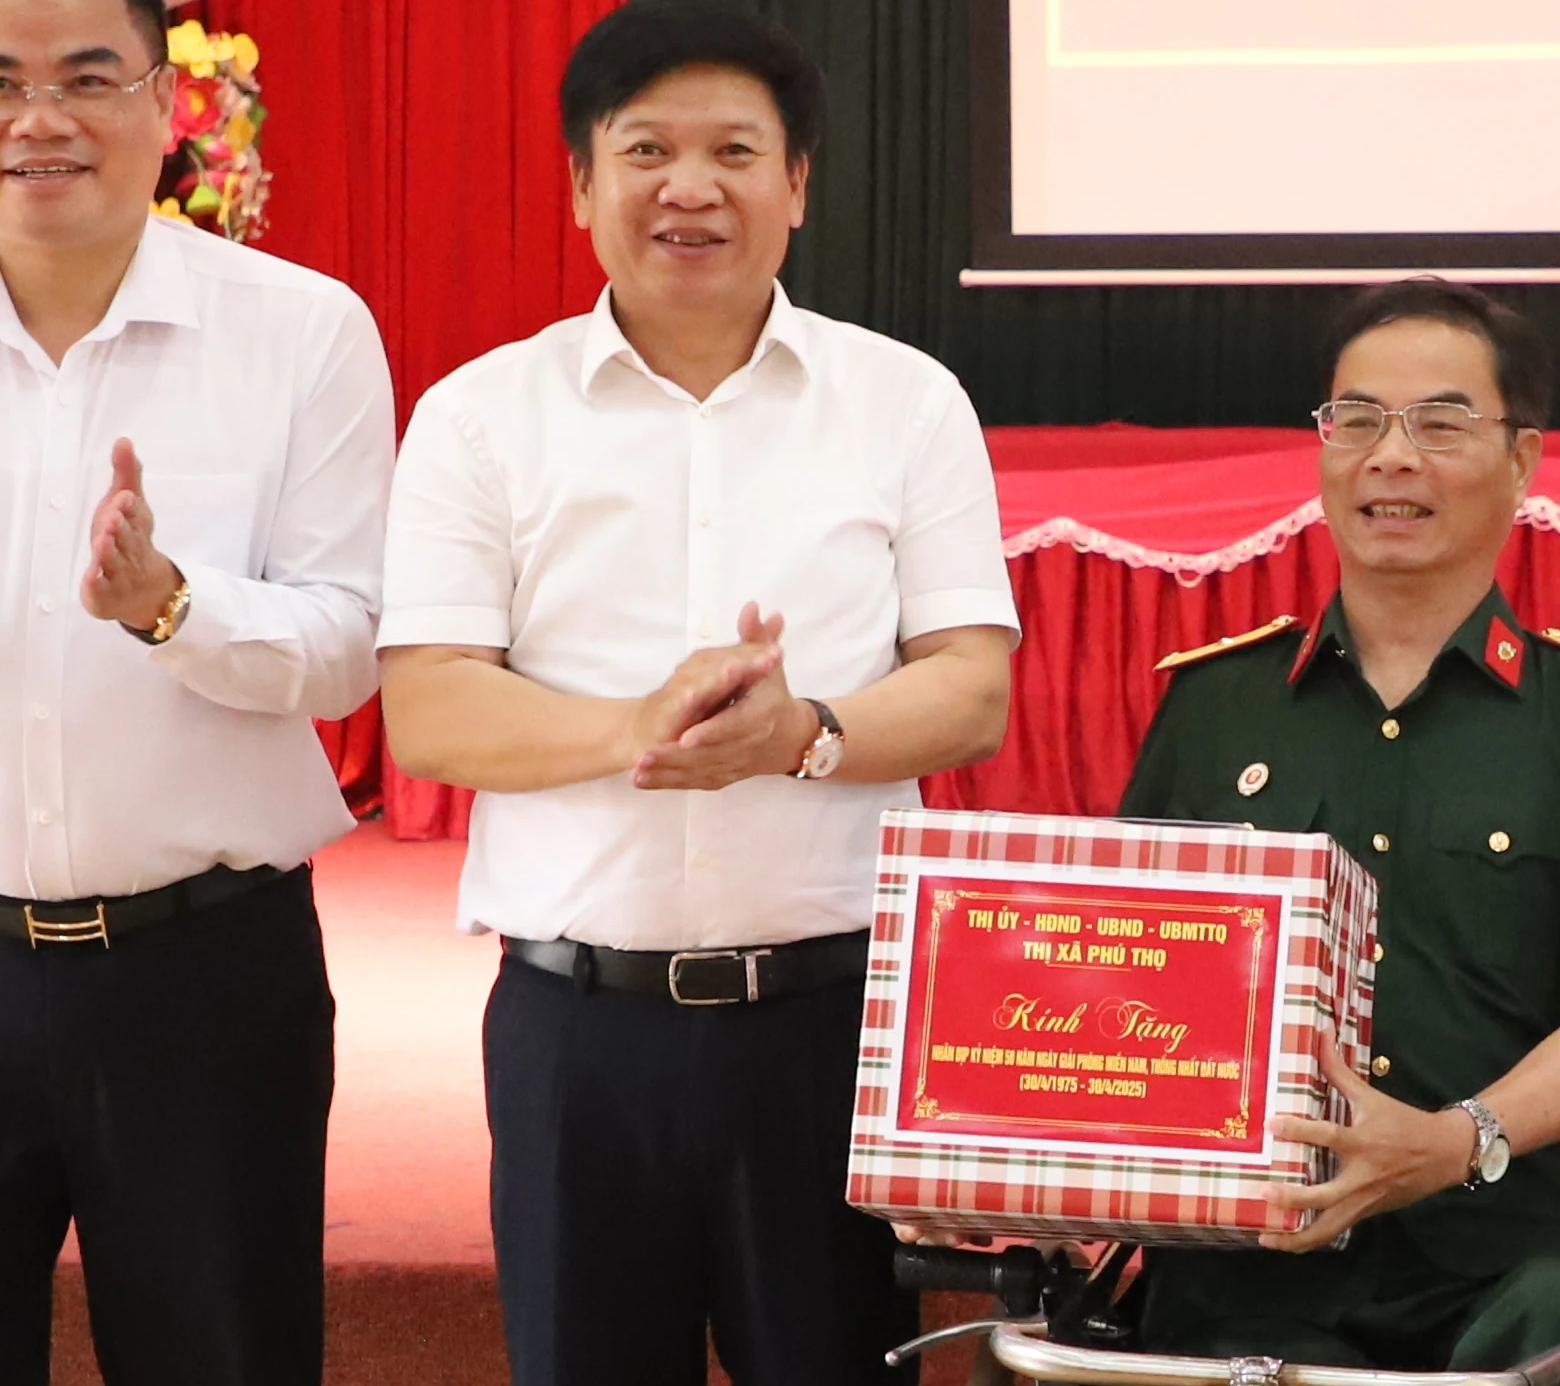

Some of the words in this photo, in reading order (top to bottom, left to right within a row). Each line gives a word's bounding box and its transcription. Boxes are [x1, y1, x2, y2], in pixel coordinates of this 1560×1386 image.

[968, 909, 993, 932] THỊ
[997, 906, 1020, 930] ỦY
[1035, 913, 1081, 934] HĐND
[1097, 916, 1144, 938] UBND
[1159, 920, 1228, 945] UBMTTQ
[1023, 941, 1052, 964] THỊ
[1056, 941, 1082, 962] XÃ
[1087, 943, 1126, 965] PHÚ
[1131, 948, 1167, 971] THỌ
[993, 993, 1088, 1034] Kính
[1095, 996, 1191, 1053] Tặng
[982, 1045, 1004, 1068] NIỆM
[1005, 1049, 1015, 1065] 50
[1077, 1051, 1104, 1071] PHÓNG
[1019, 1074, 1078, 1093] (30/4/1975
[1087, 1078, 1147, 1098] 30/4/2025)
